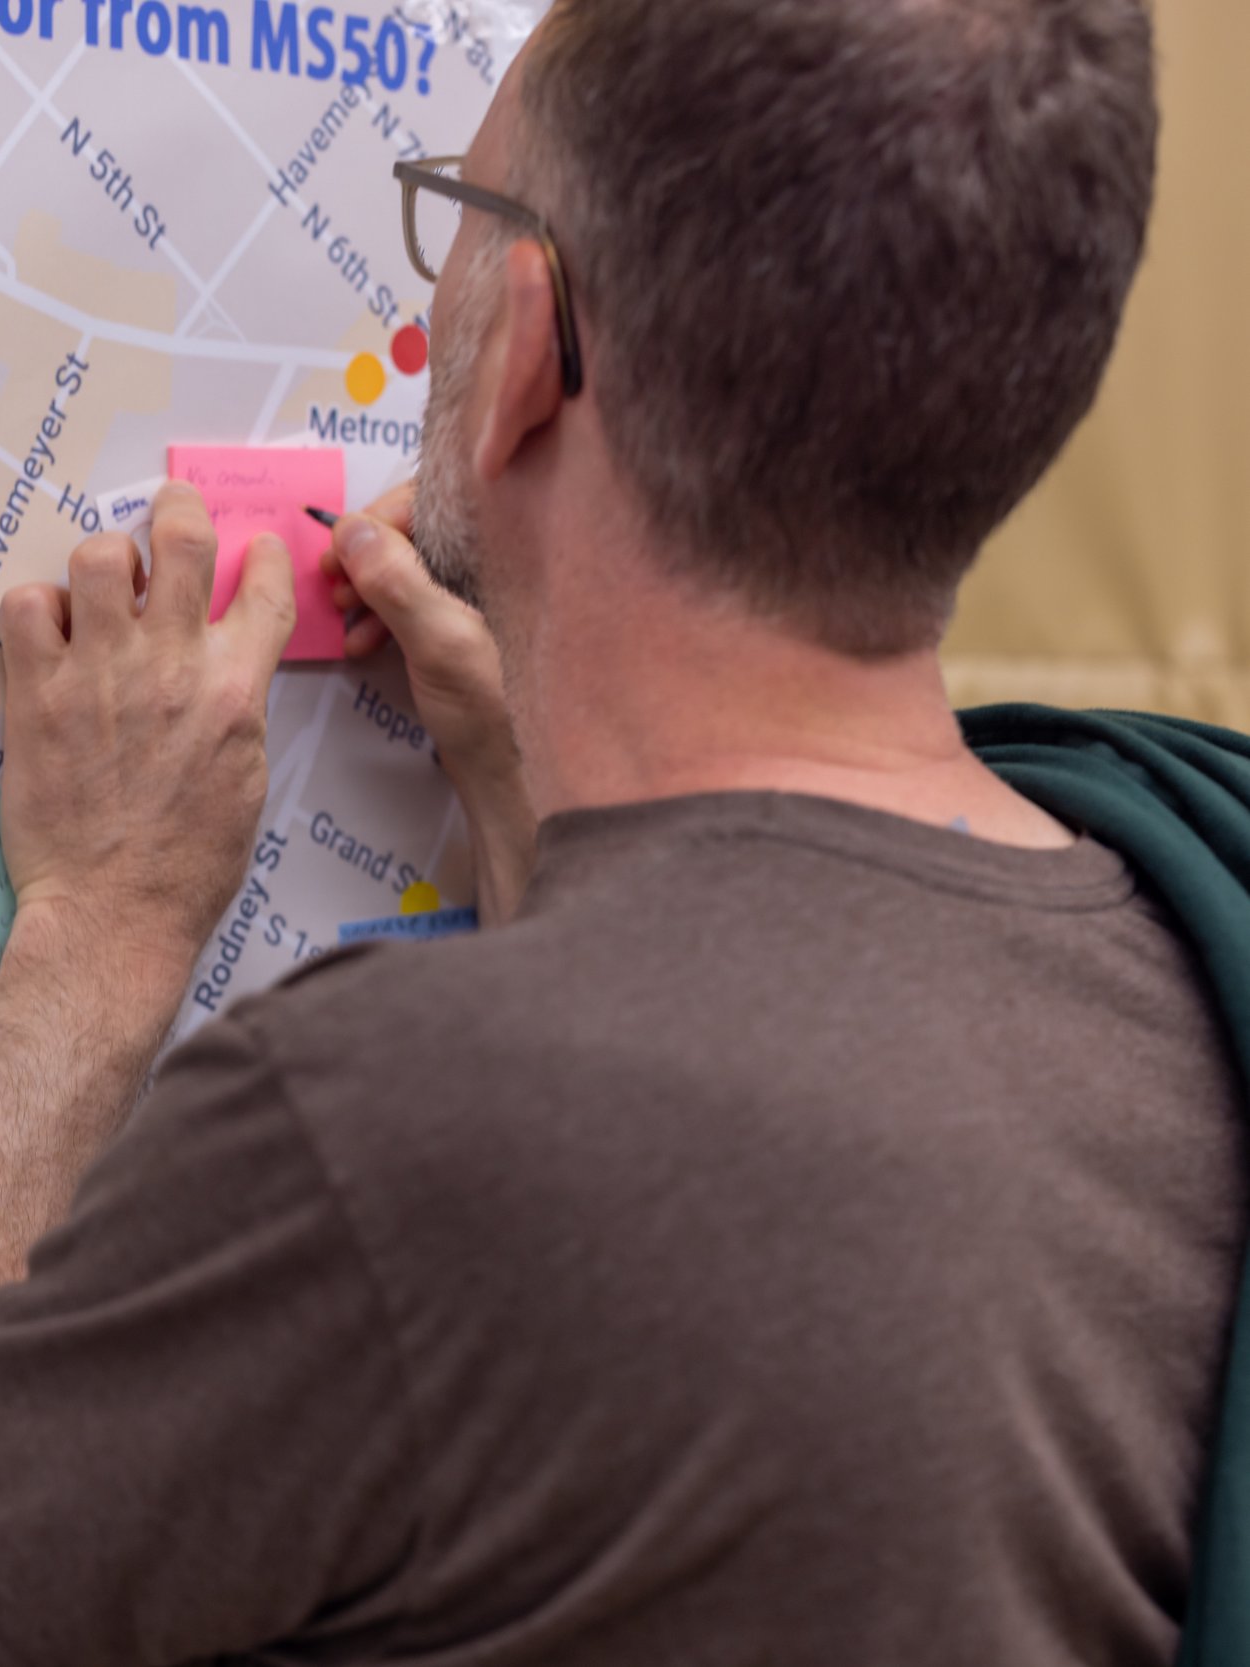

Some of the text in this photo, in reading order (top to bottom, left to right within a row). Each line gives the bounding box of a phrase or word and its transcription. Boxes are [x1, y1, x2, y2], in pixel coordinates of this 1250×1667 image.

[251, 0, 437, 96] MS50?
[371, 102, 401, 140] N
[60, 116, 168, 250] N 5th St
[300, 202, 400, 328] N 6th St
[54, 350, 90, 396] St
[352, 680, 426, 750] Hope
[309, 809, 393, 882] Grand
[193, 829, 289, 1012] Rodney St
[263, 912, 287, 947] S
